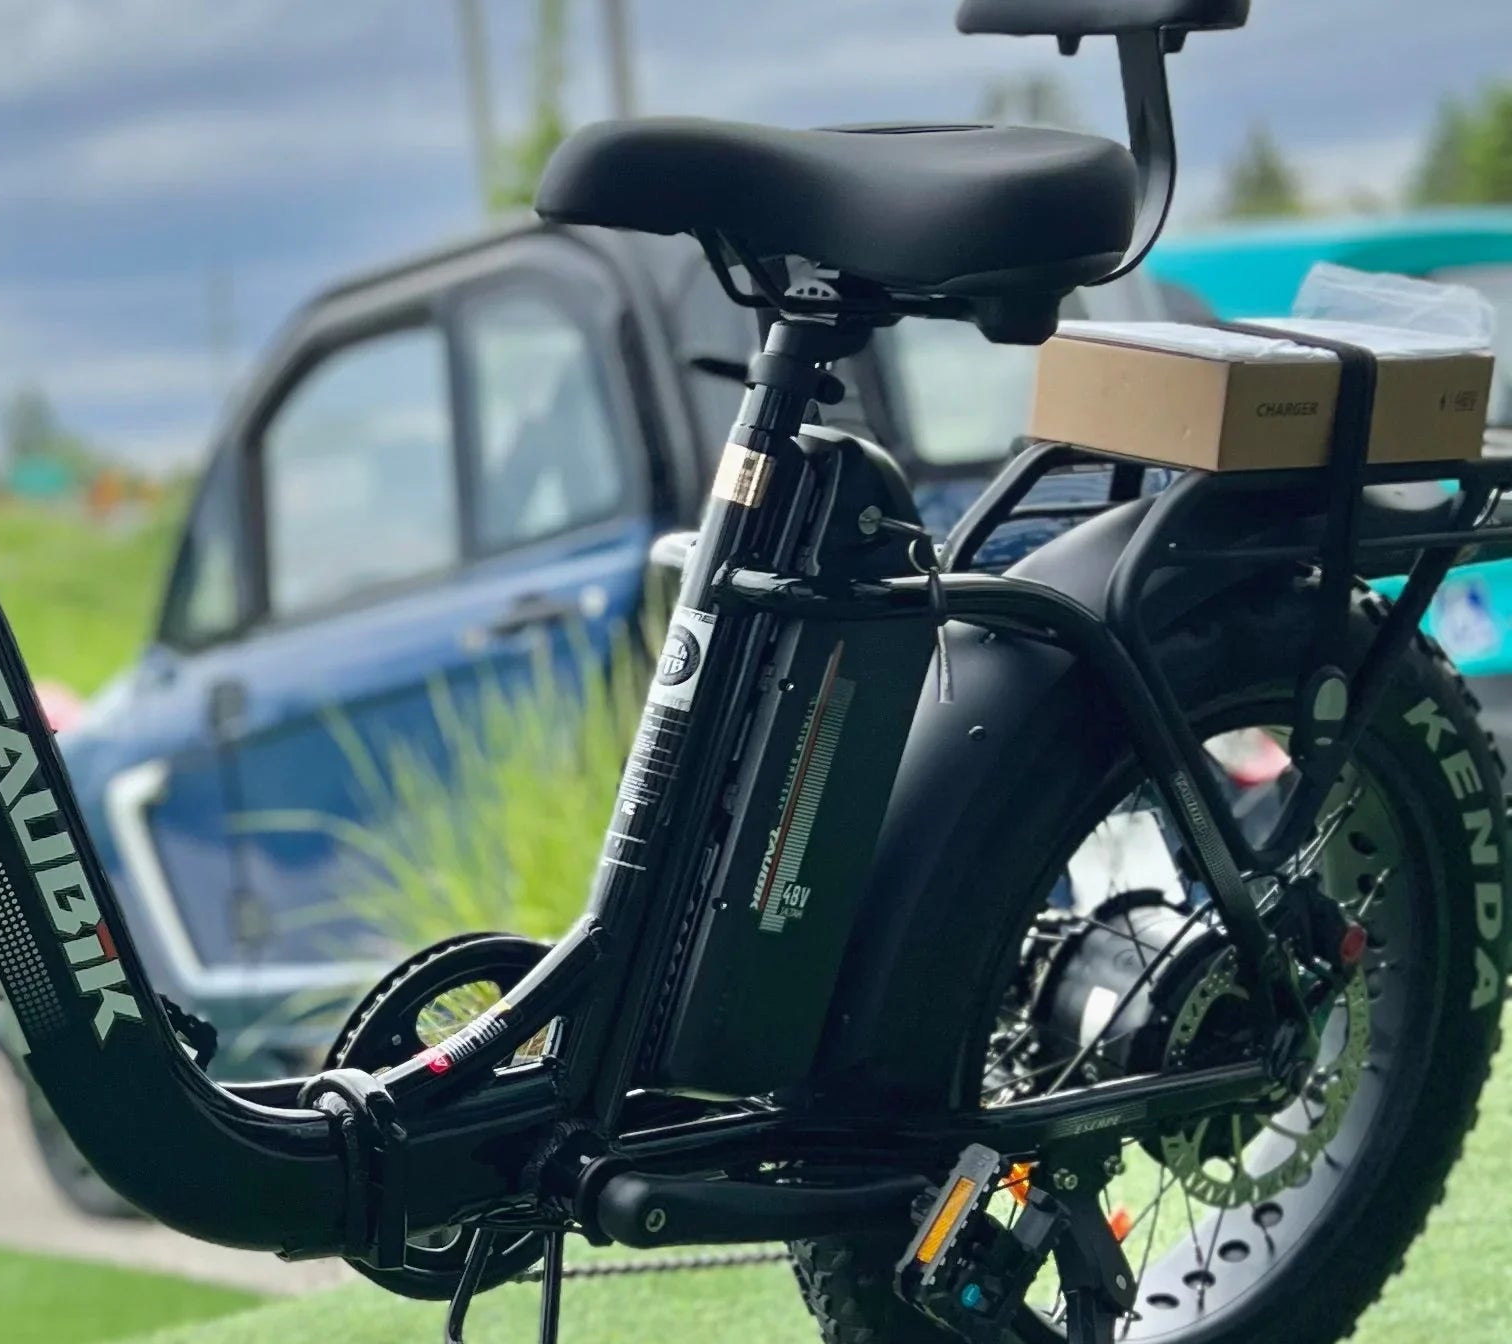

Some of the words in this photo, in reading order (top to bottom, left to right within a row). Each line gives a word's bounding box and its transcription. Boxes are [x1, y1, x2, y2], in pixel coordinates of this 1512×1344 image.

[1255, 400, 1320, 418] CHARGER
[1402, 697, 1499, 1011] KENDA
[782, 883, 812, 908] 48V
